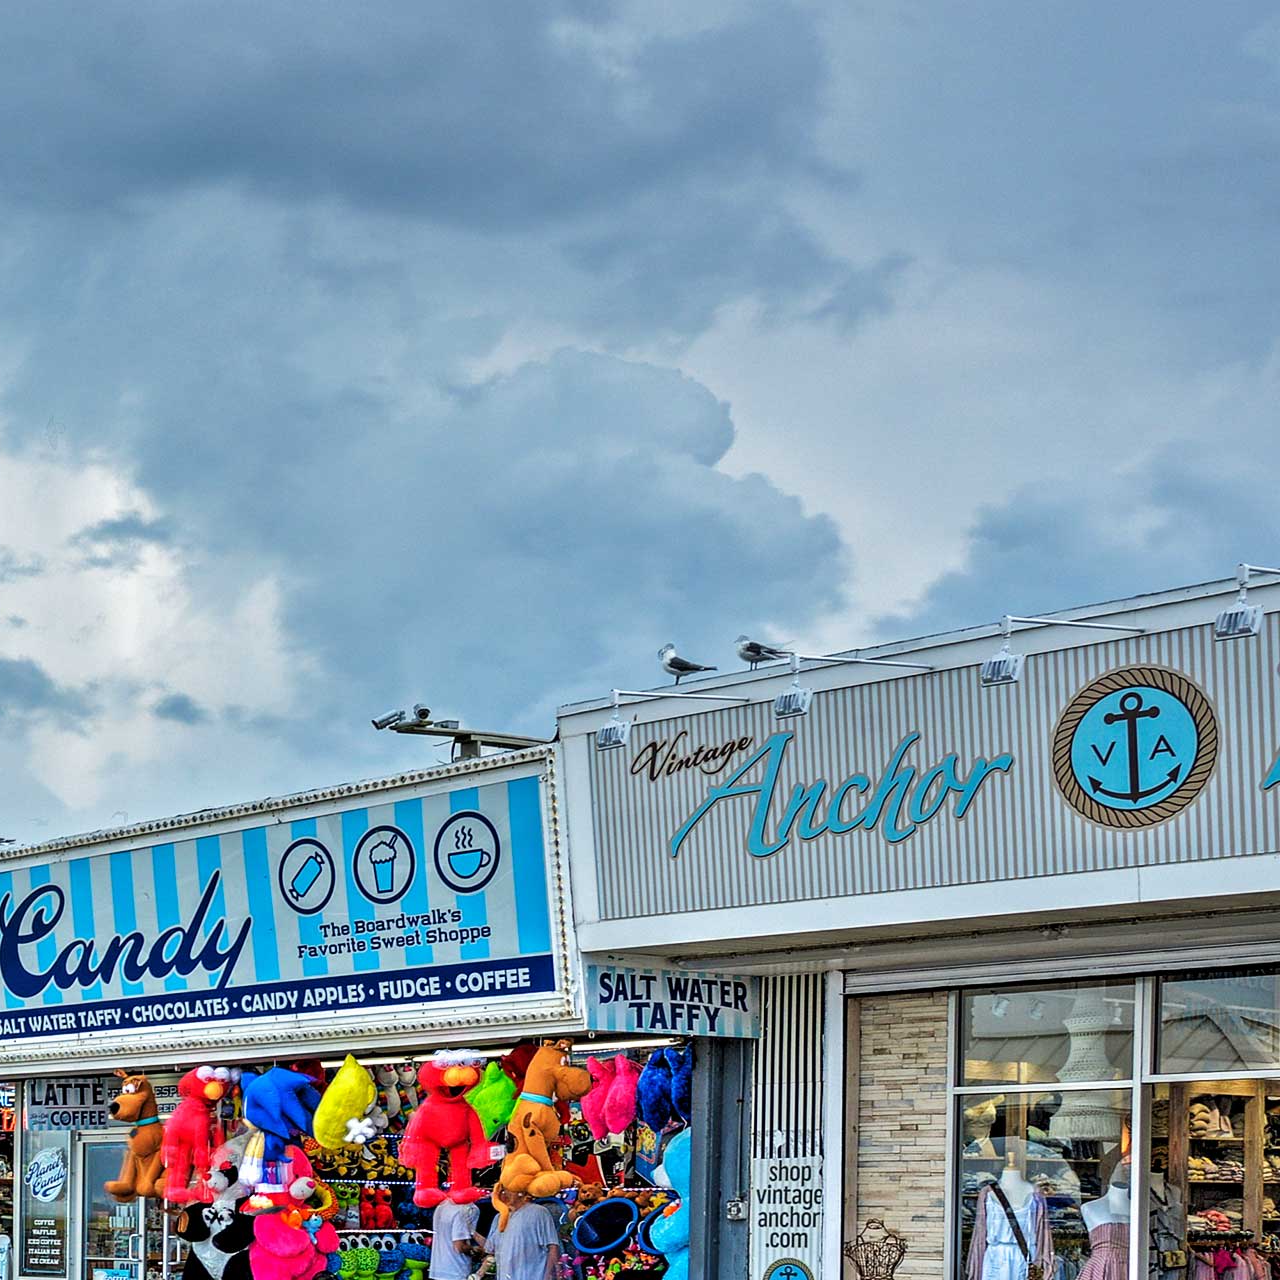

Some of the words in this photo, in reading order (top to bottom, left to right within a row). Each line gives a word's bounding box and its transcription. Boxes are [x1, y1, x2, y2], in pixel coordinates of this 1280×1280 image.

[630, 730, 753, 782] Vintage
[1090, 741, 1116, 767] V
[1149, 734, 1177, 761] A
[670, 731, 1014, 858] Anchor
[319, 922, 351, 940] The
[354, 907, 462, 935] Boardwalk's
[297, 938, 367, 959] Favorite
[370, 930, 423, 951] Sweet
[426, 924, 492, 945] Shoppe
[28, 1012, 76, 1033] WATER
[77, 1007, 122, 1028] TAFFY
[132, 998, 230, 1023] CHOCOLATES
[240, 990, 299, 1013] CANDY
[302, 983, 367, 1008] APPLES
[378, 976, 442, 1001] FUDGE
[455, 967, 532, 993] COFFEE
[598, 971, 657, 1004] SALT
[666, 976, 748, 1012] WATER
[628, 1002, 722, 1032] TAFFY
[30, 1080, 105, 1107] LATTE
[50, 1110, 106, 1127] COFFEE
[24, 1155, 64, 1184] Planet
[32, 1171, 67, 1197] Candy
[769, 1160, 812, 1187] shop
[756, 1184, 823, 1210] vintage
[758, 1206, 821, 1228] anchor
[765, 1232, 808, 1248] .com
